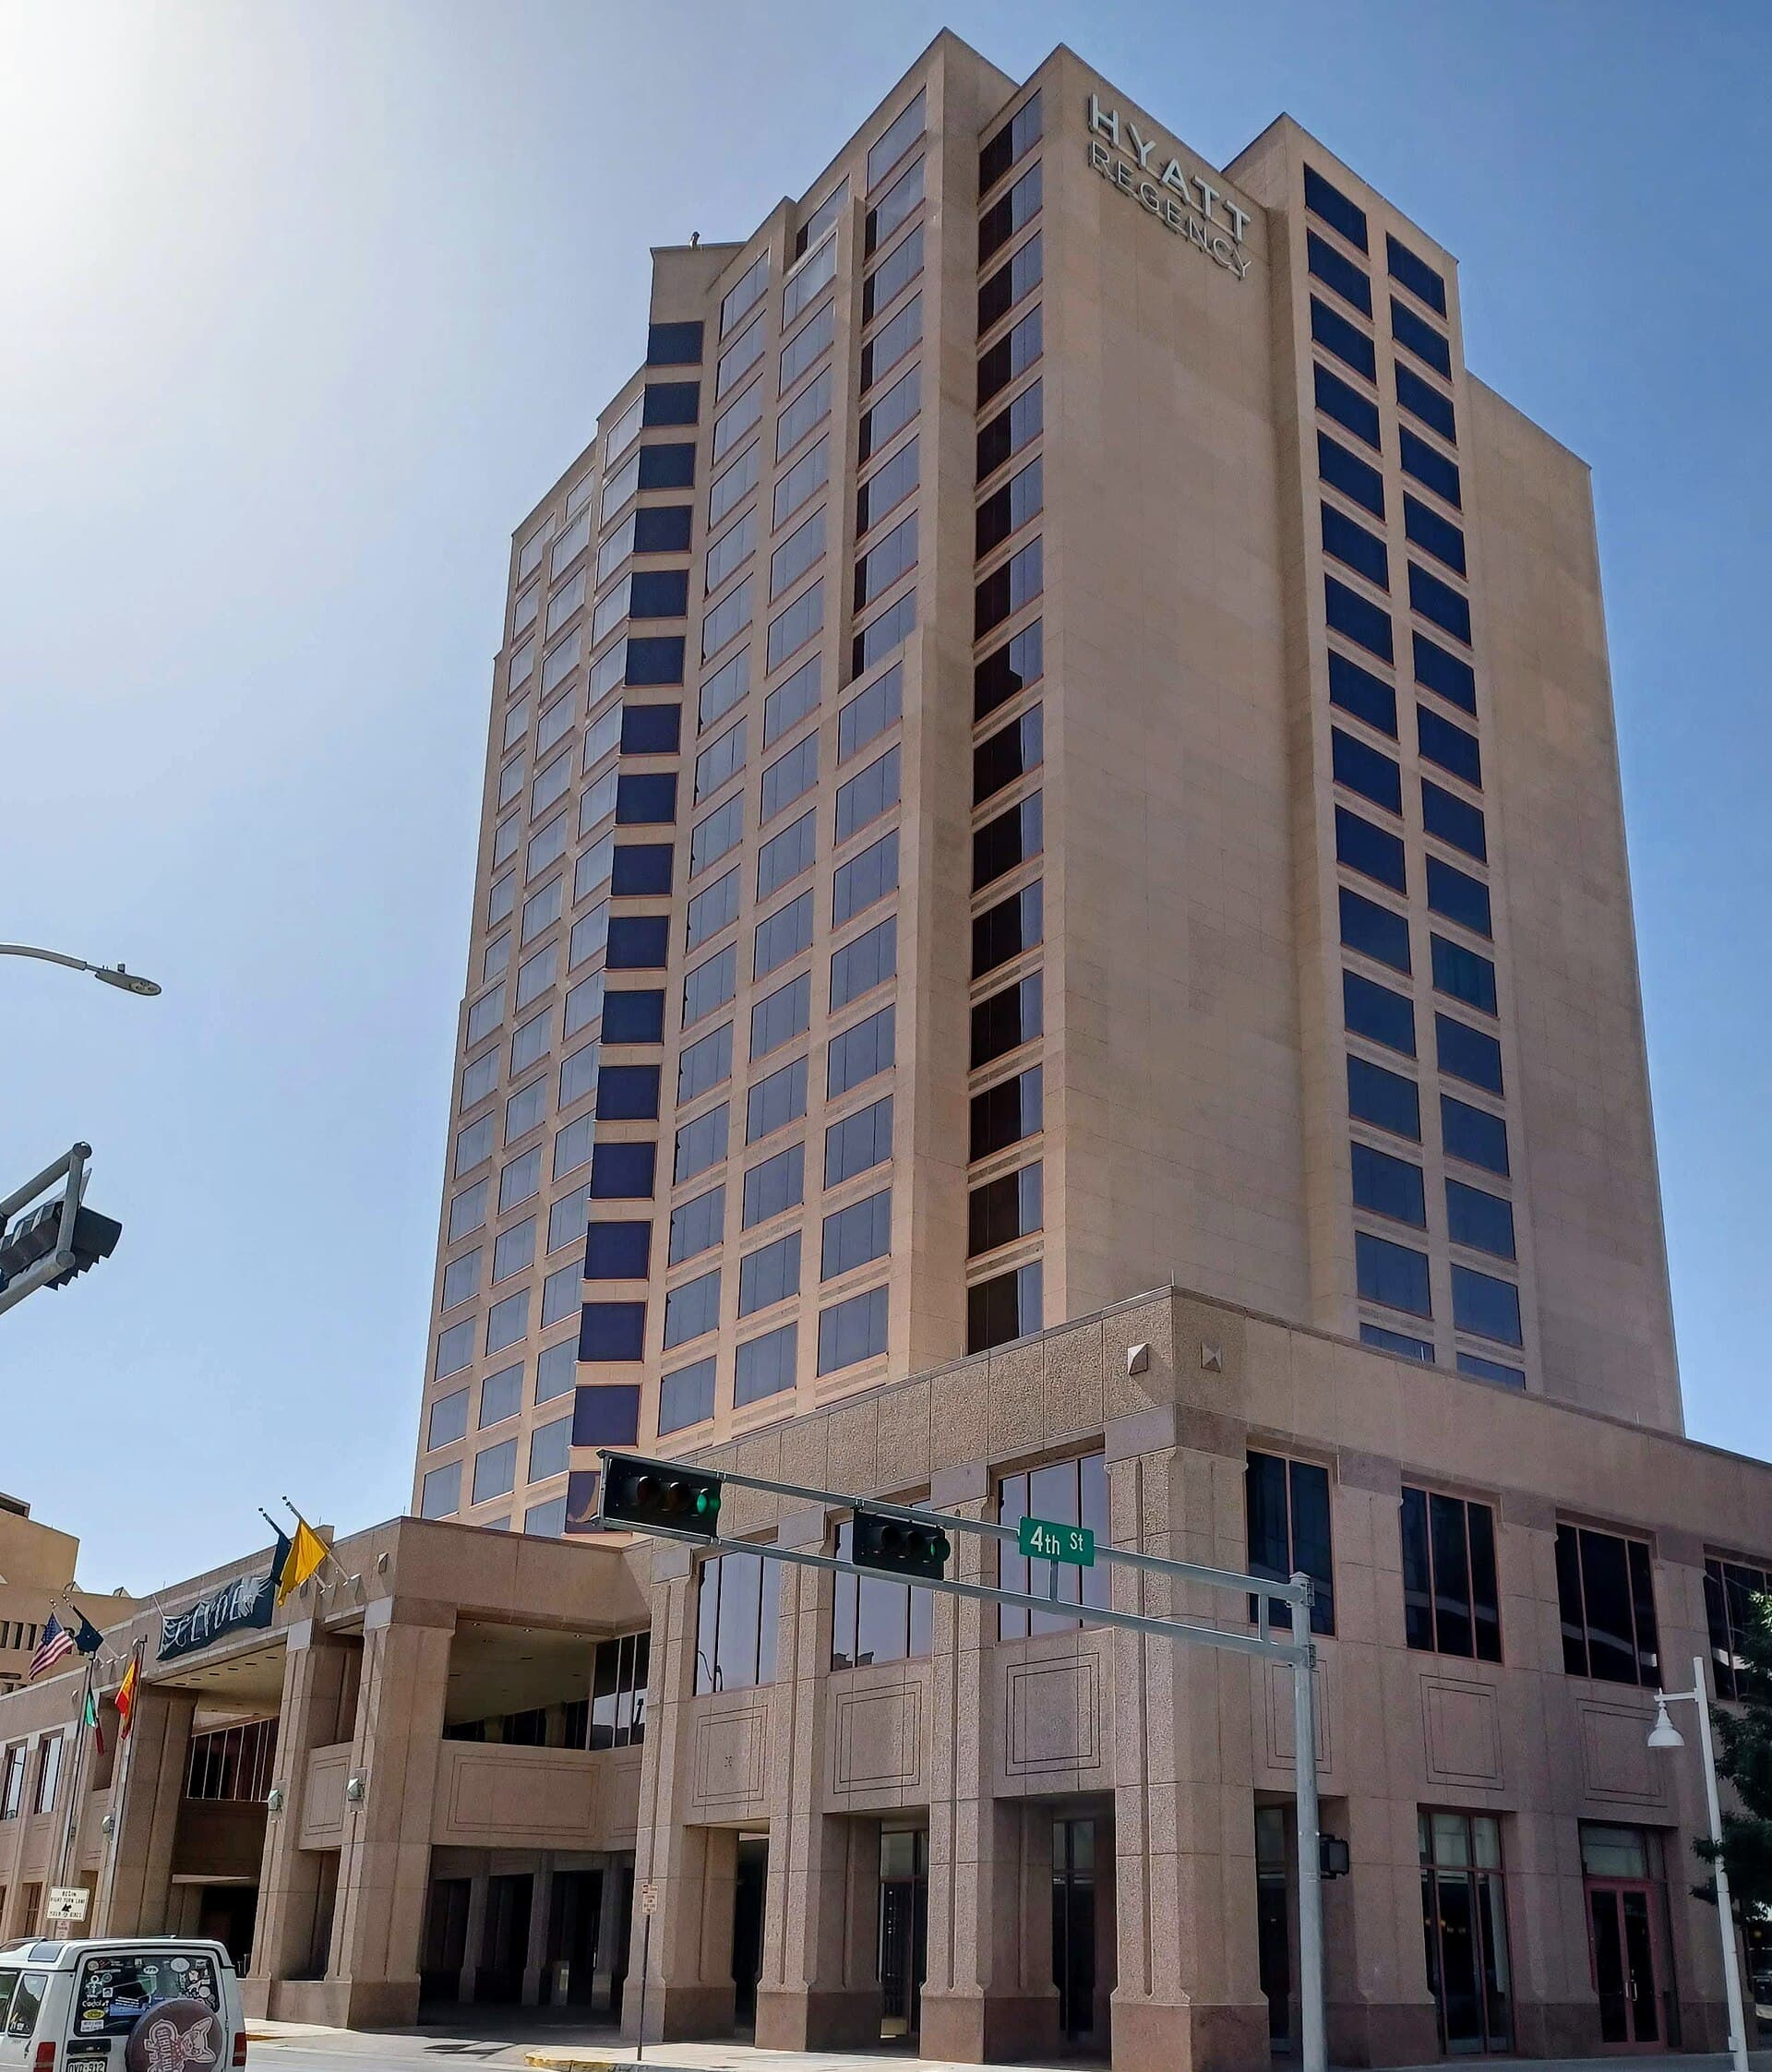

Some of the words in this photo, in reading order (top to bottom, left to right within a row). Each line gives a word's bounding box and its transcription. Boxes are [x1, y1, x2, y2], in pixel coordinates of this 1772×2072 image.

[1089, 93, 1251, 246] HYATT
[1090, 140, 1251, 280] REGENCY
[1030, 1526, 1060, 1555] 4th
[1070, 1532, 1084, 1551] St
